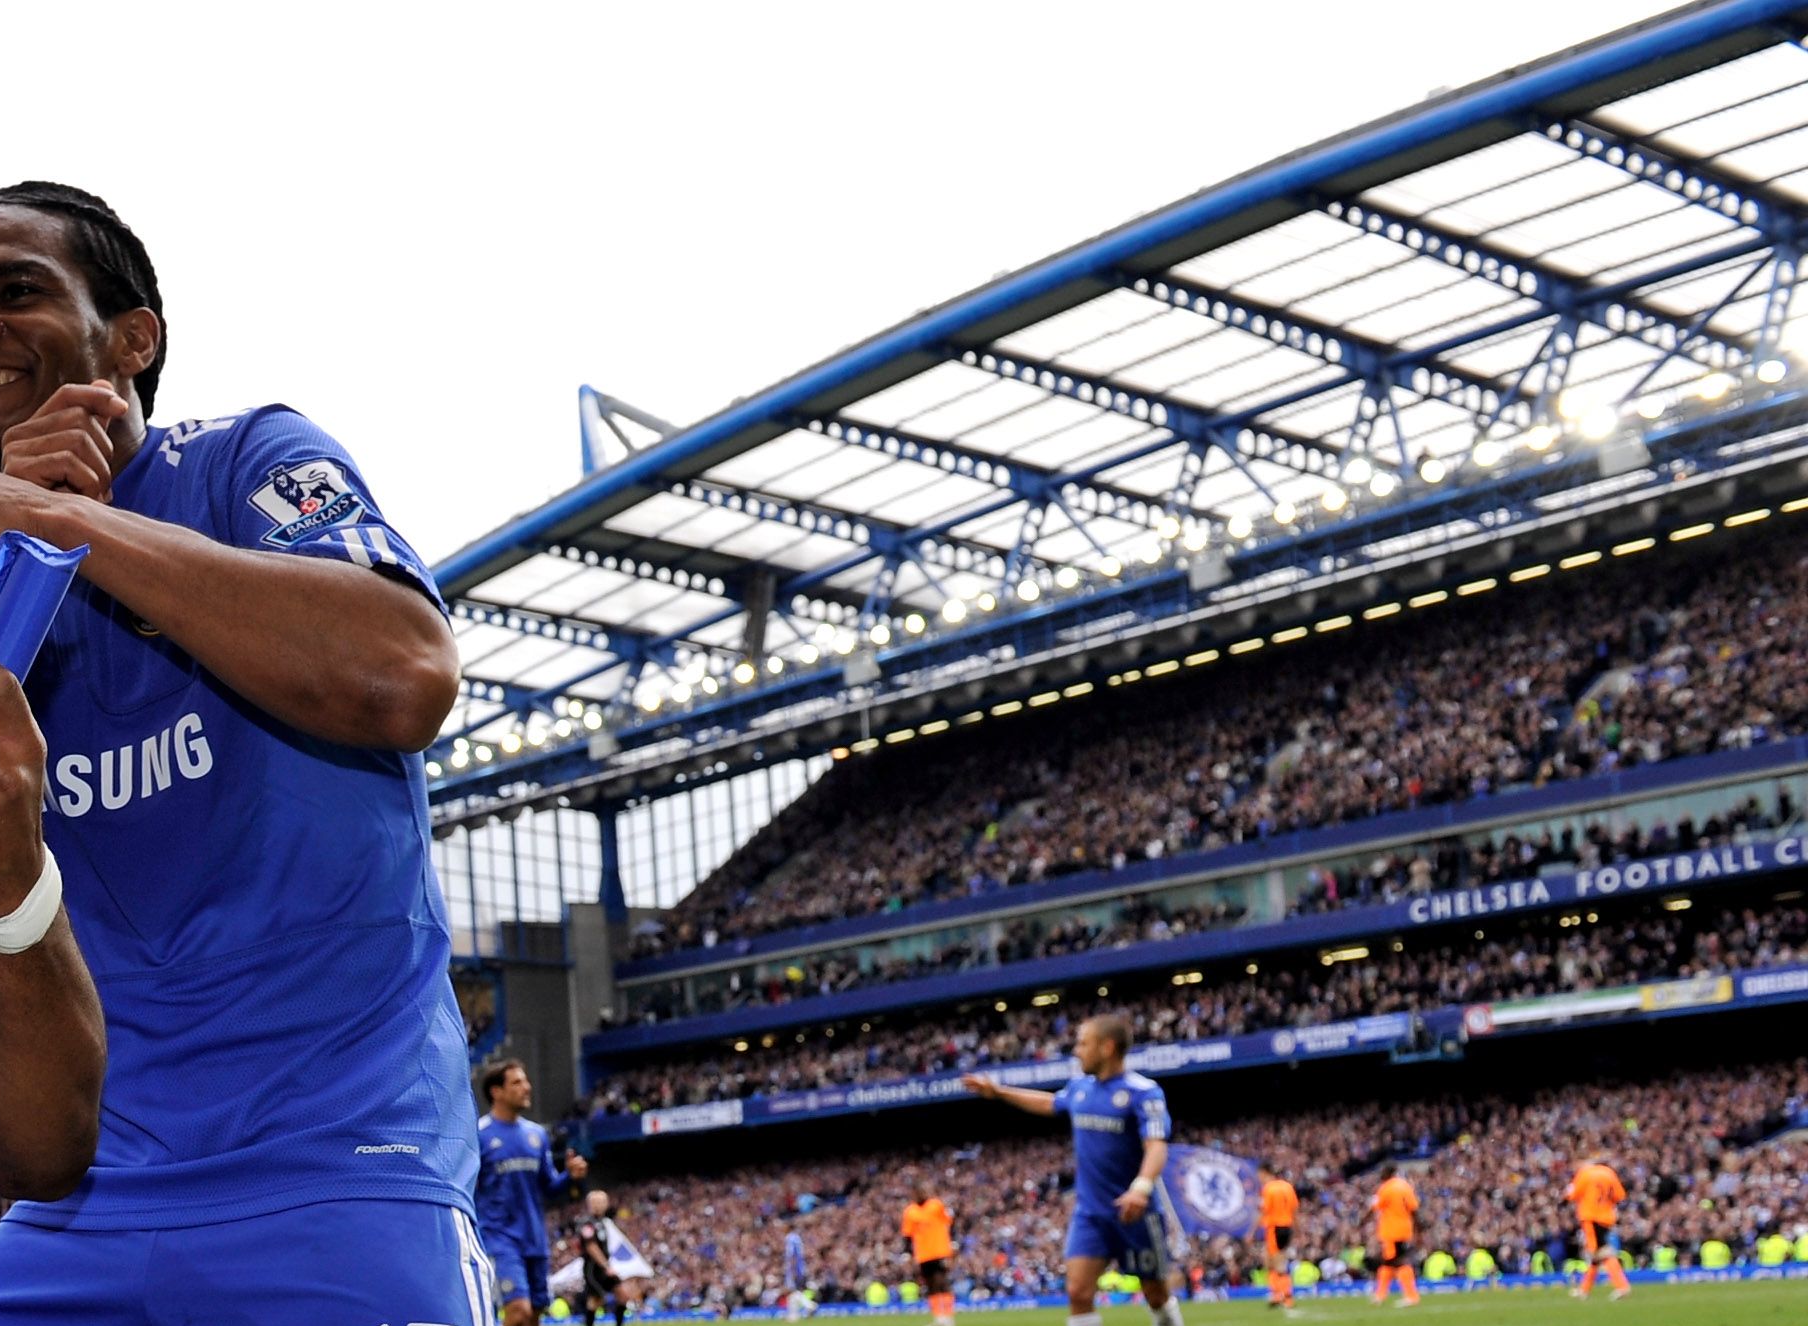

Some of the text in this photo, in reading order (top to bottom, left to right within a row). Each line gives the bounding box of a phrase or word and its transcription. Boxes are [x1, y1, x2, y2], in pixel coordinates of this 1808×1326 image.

[286, 496, 350, 536] BARCLAYS
[42, 713, 213, 818] SUNG
[1408, 879, 1550, 924] CHELSEA
[1576, 846, 1763, 897] FOOTBALL
